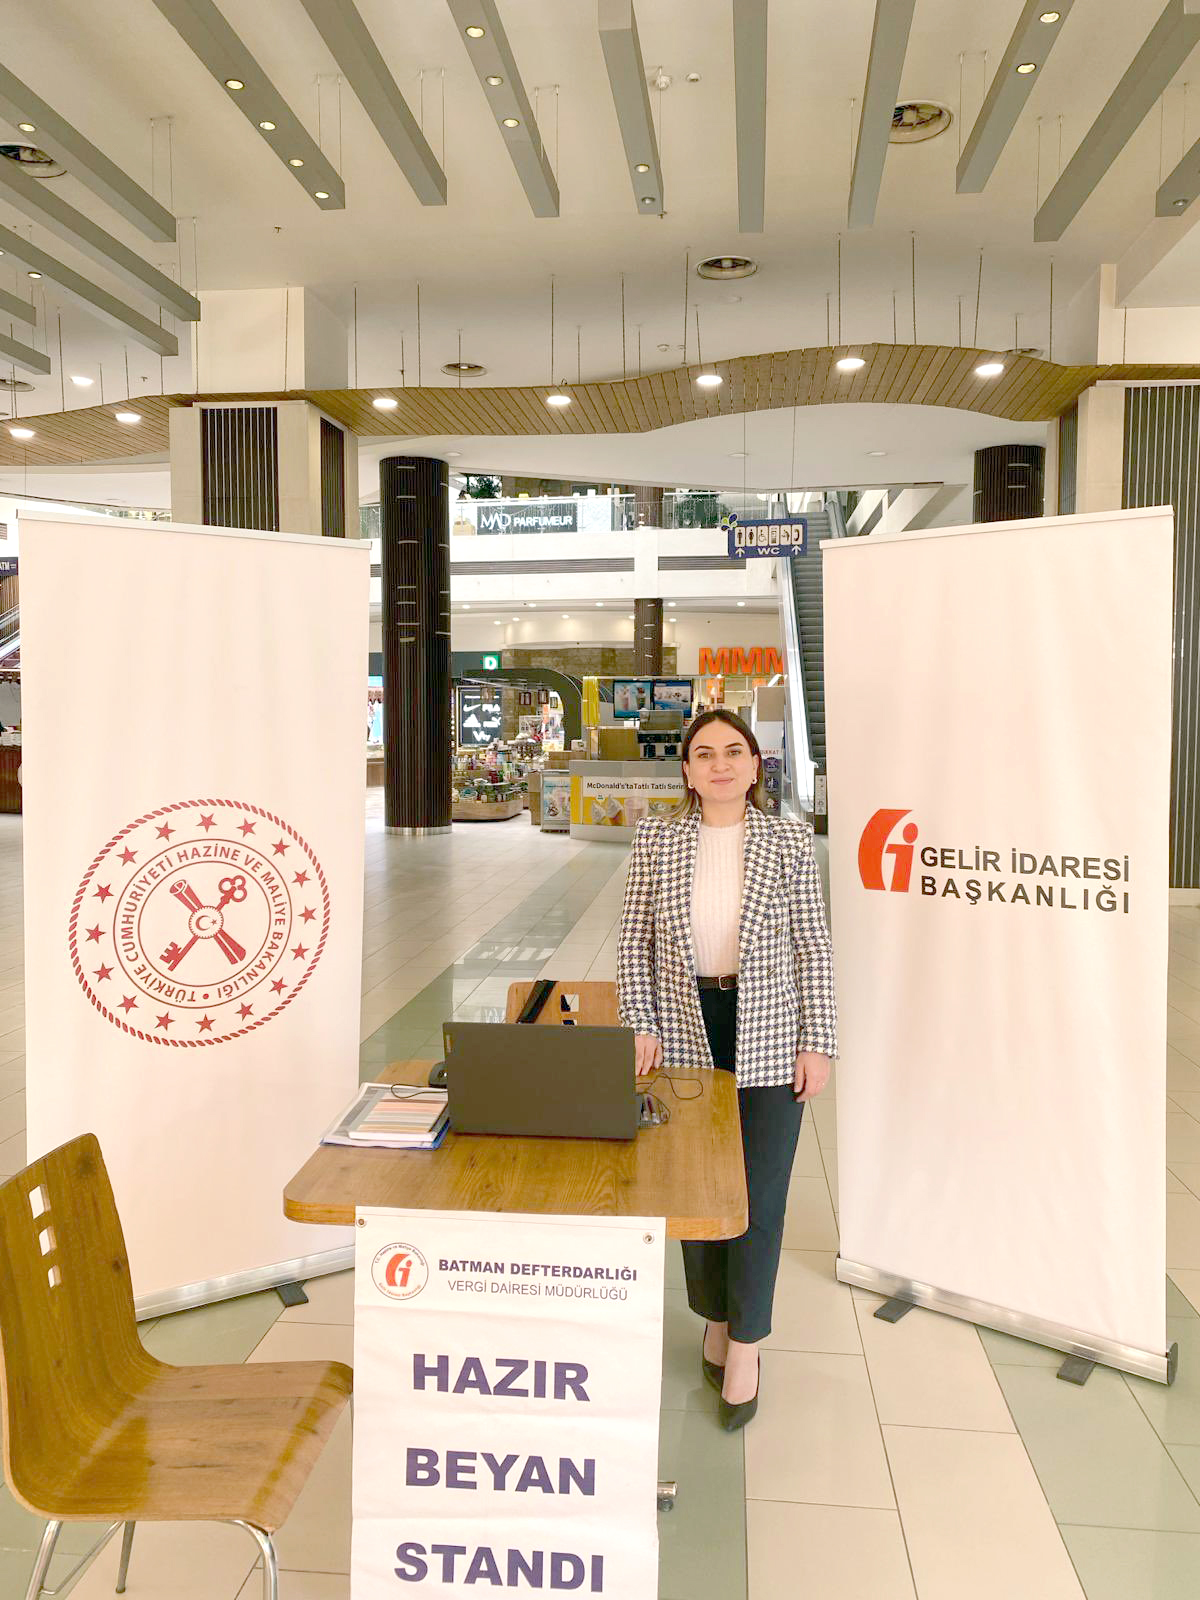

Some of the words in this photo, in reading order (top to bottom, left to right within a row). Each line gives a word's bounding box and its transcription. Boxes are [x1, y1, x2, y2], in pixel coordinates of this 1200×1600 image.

[480, 512, 511, 530] MAD
[513, 515, 573, 527] PARFUMEUR
[757, 546, 780, 555] WC
[177, 842, 239, 864] HAZİNE
[242, 852, 263, 873] VE
[920, 845, 1001, 872] GELİR
[1011, 848, 1129, 882] İDARESİ
[121, 854, 174, 963] CUMHURİYETİ
[260, 871, 286, 926] MALİYE
[921, 875, 1129, 914] BAŞKANLIĞI
[133, 961, 197, 1003] TÜRKİYE
[216, 931, 284, 999] BAKANLIĞI
[438, 1259, 504, 1275] BATMAN
[510, 1263, 637, 1281] DEFTERDARLIĞI
[447, 1279, 487, 1293] VERGİ
[491, 1281, 541, 1296] DAİRESİ
[545, 1283, 628, 1301] MÜDÜRLÜĞÜ
[413, 1354, 591, 1401] HAZIR
[405, 1447, 596, 1496] BEYAN
[394, 1542, 604, 1593] STANDI
